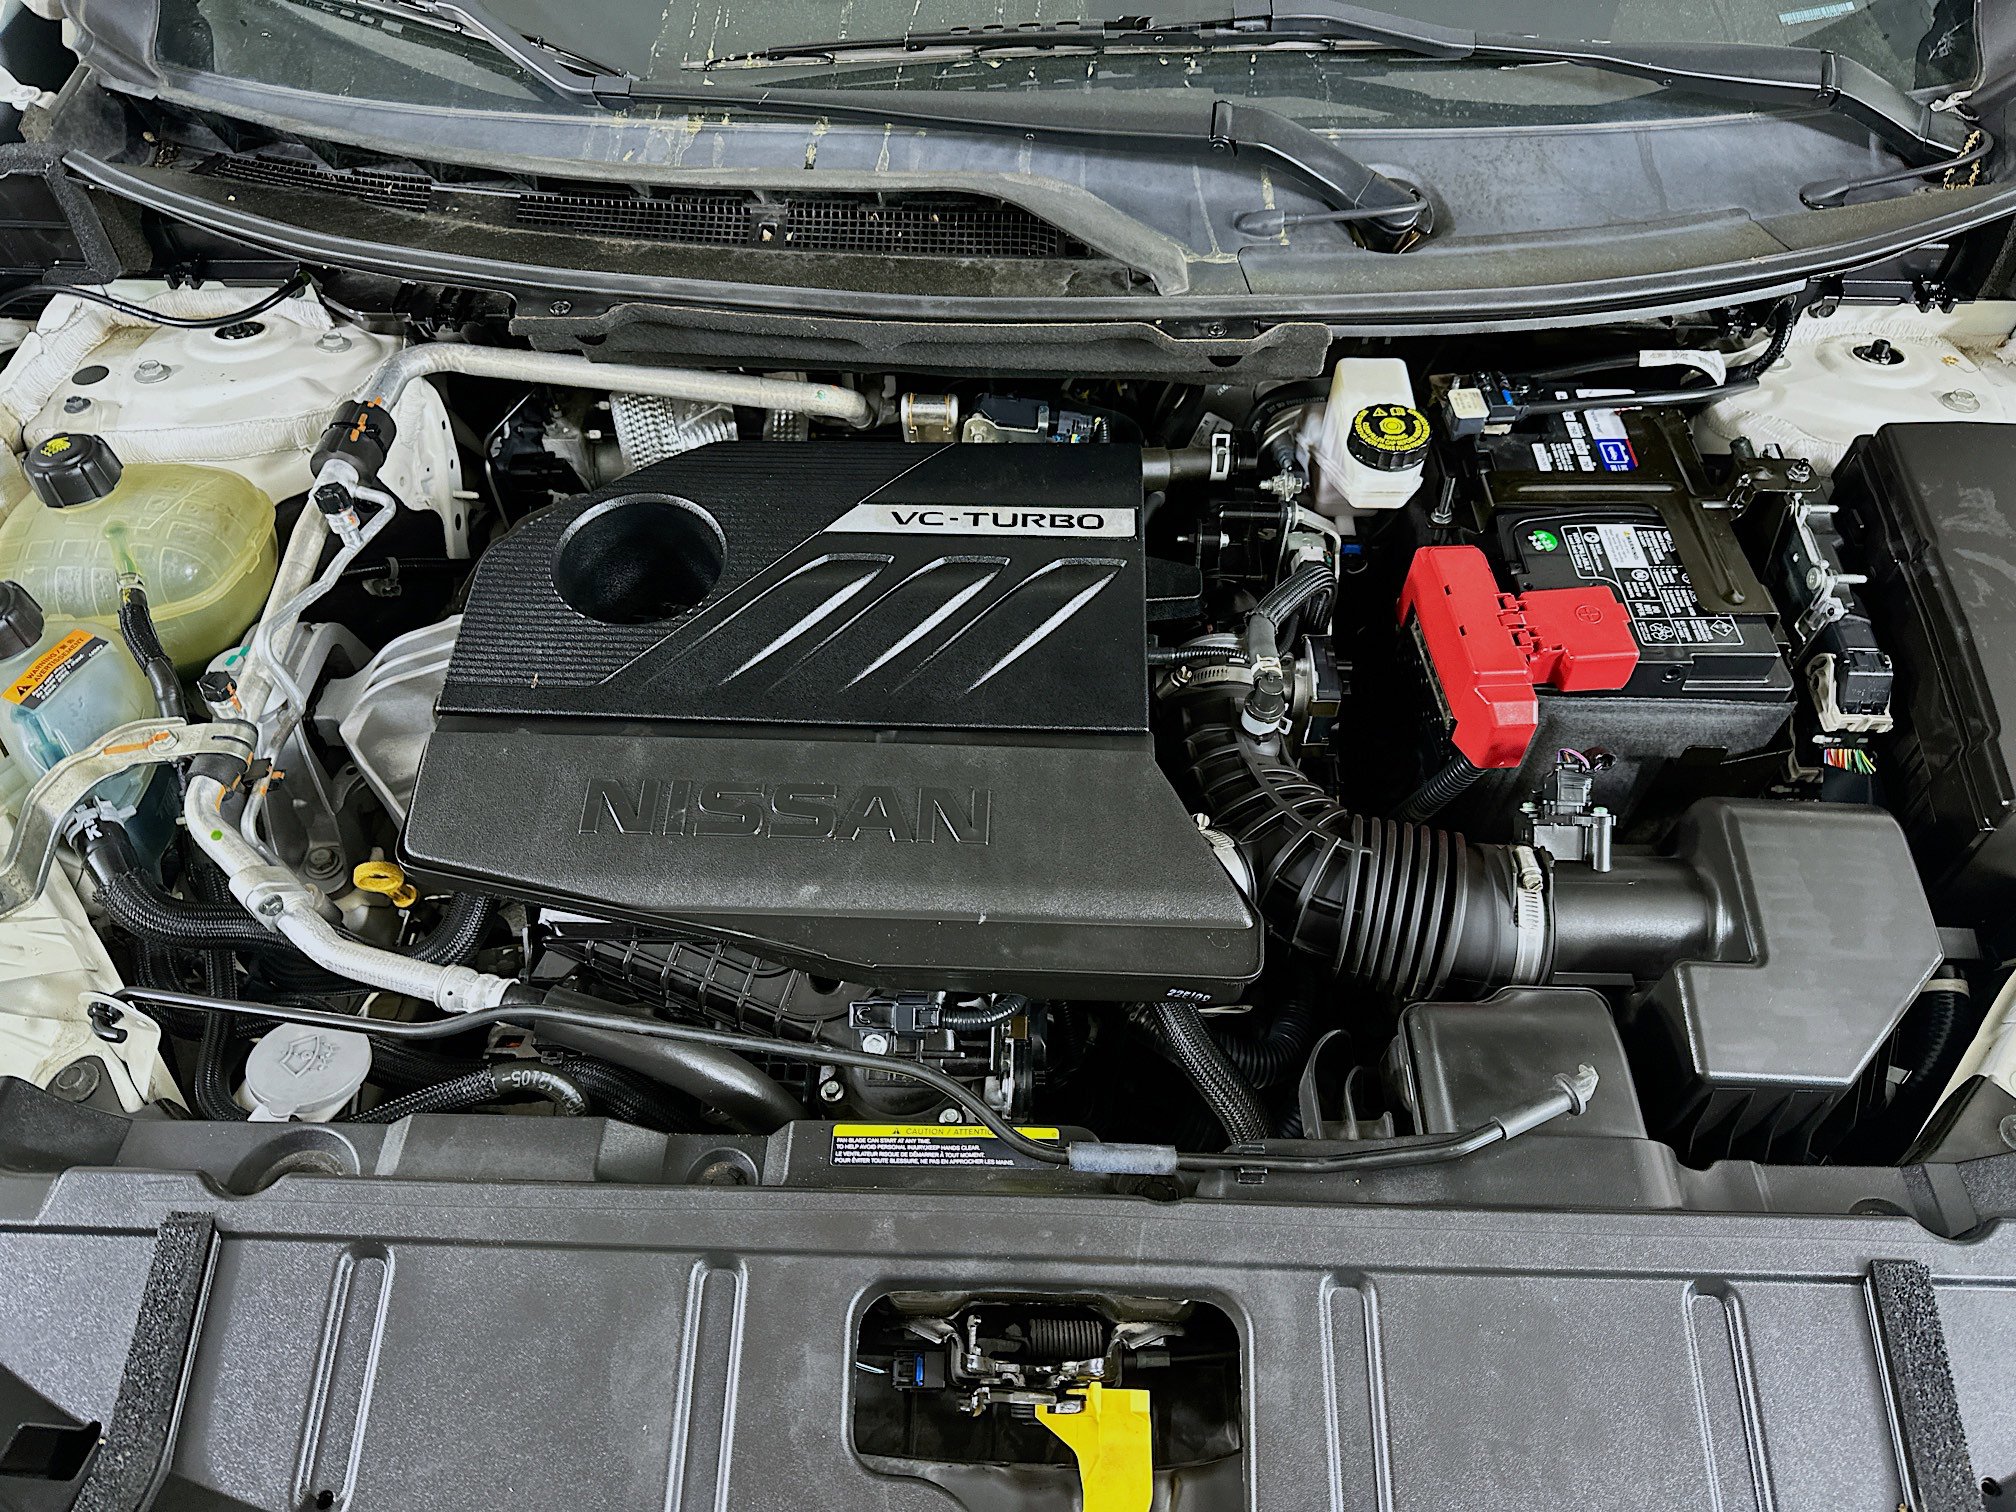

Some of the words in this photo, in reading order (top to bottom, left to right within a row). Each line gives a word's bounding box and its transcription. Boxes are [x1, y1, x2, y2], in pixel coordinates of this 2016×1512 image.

[891, 510, 1104, 530] VC-TURBO
[27, 653, 57, 680] WARNING
[34, 637, 84, 683] AVERTISSEMENT
[578, 778, 992, 845] NISSAN
[906, 1127, 944, 1135] CAUTION
[953, 1128, 994, 1136] ATTENTIO
